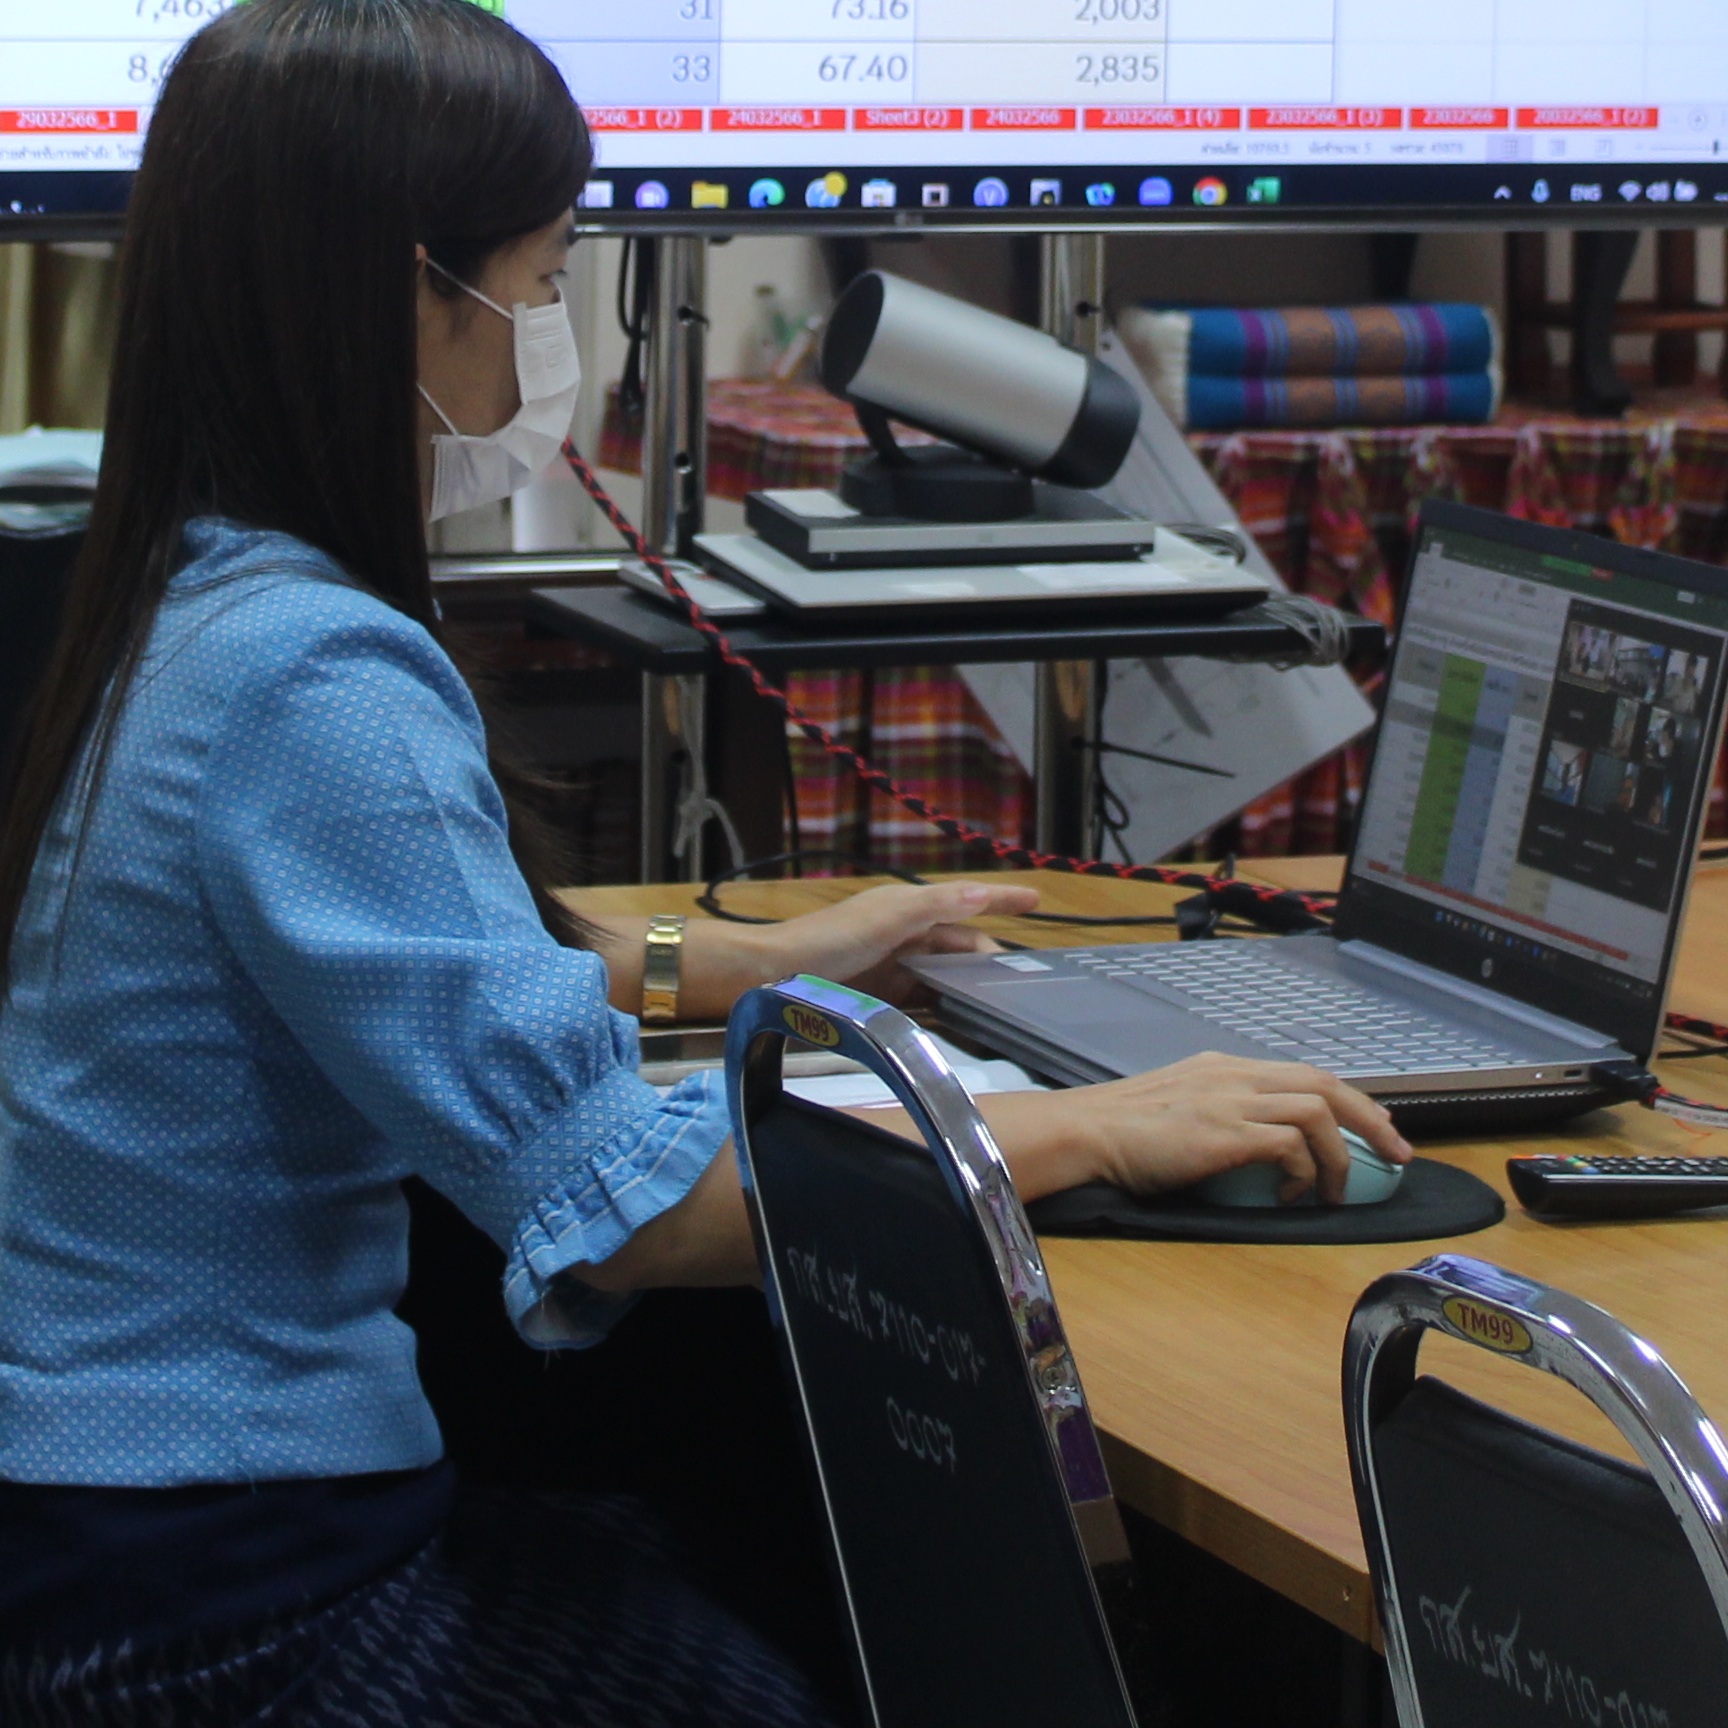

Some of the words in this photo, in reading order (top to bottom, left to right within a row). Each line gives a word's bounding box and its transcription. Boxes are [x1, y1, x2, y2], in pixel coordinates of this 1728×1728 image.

[673, 55, 710, 82] 33
[818, 55, 908, 81] 67.40
[1077, 55, 1159, 86] 2,835
[584, 110, 647, 128] 2566_1
[865, 109, 919, 125] Sheet3
[1457, 1302, 1514, 1345] TM99
